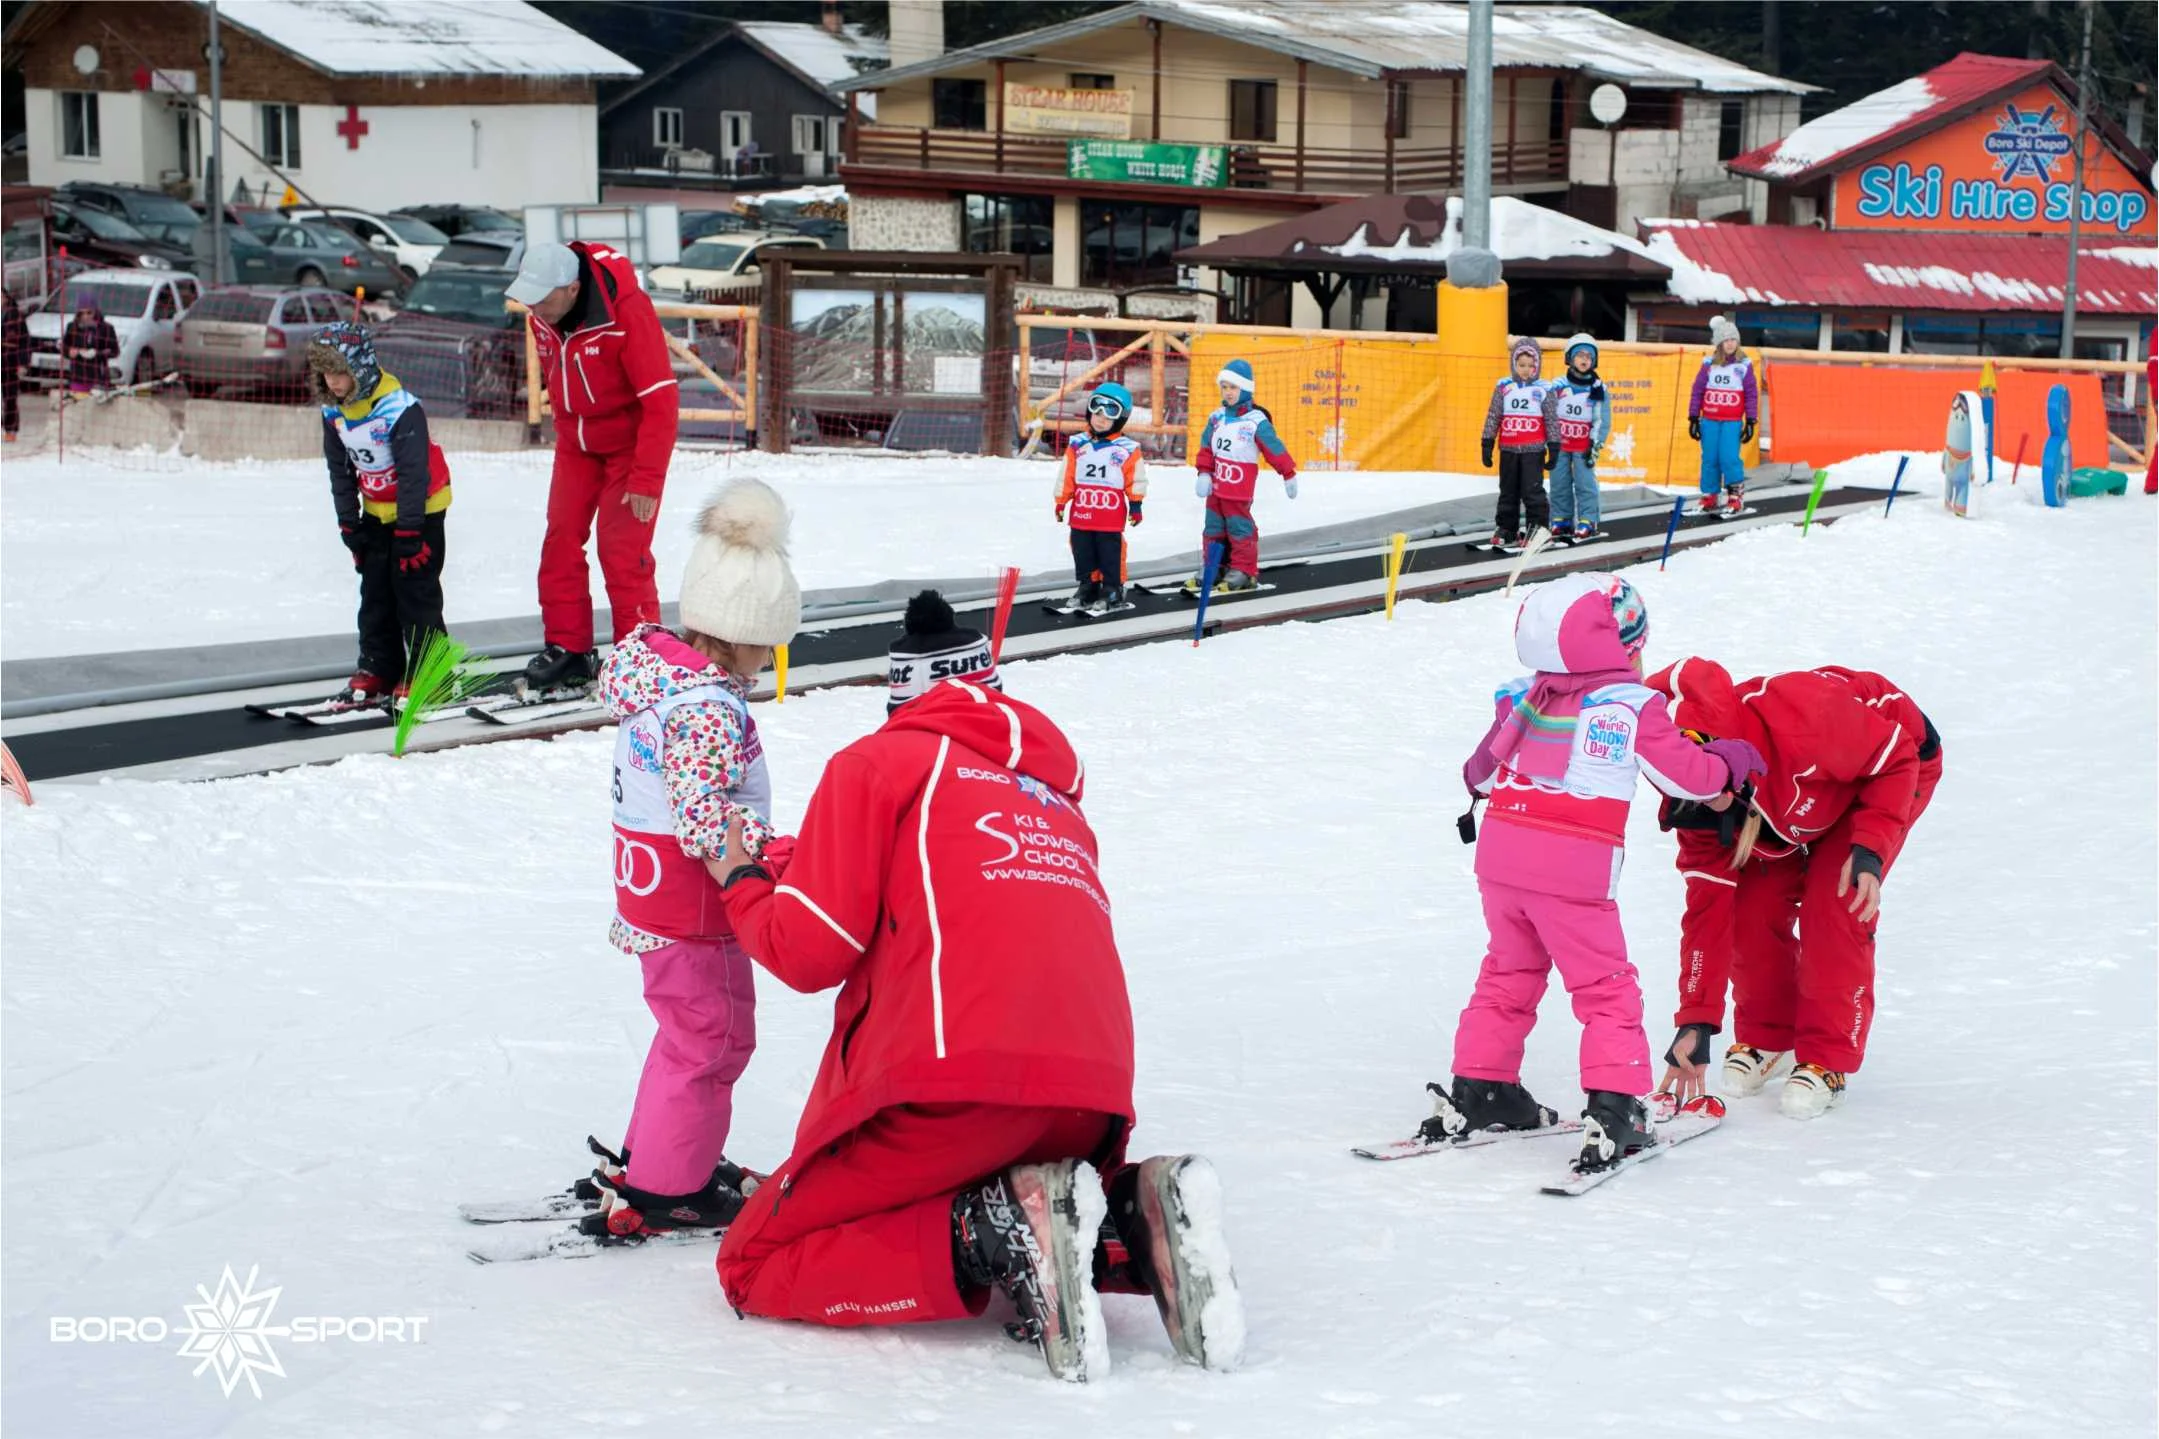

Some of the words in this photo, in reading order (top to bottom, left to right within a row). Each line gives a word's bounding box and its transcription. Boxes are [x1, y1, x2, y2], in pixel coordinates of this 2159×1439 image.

[2016, 137, 2031, 149] Ski
[2034, 138, 2069, 152] Depot
[1858, 162, 1944, 219] Ski
[1950, 180, 2038, 221] Hire
[1714, 374, 1730, 385] 05
[1511, 398, 1529, 409] 02
[1565, 404, 1582, 415] 30
[1216, 438, 1232, 452] 02
[1086, 464, 1106, 478] 21
[1073, 511, 1092, 520] Audi
[929, 648, 991, 680] Sure
[1597, 719, 1624, 732] World
[1589, 723, 1626, 746] Snow
[1590, 740, 1610, 756] Day
[956, 767, 1011, 785] BORO
[825, 1301, 861, 1316] HELLY
[863, 1298, 917, 1315] HANSEN
